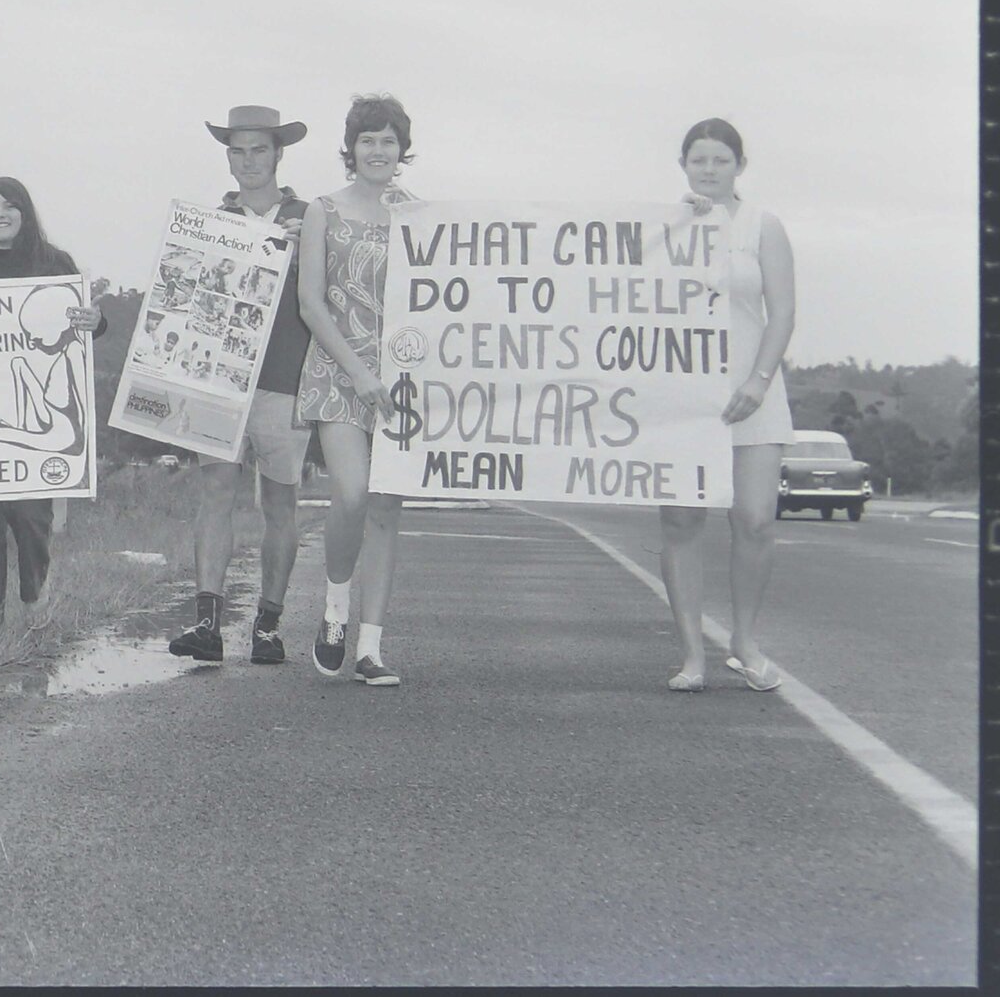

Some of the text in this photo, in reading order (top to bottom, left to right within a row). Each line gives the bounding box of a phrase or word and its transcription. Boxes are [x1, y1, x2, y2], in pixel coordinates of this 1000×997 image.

[170, 222, 254, 253] Christian Action!
[174, 211, 205, 228] World
[400, 221, 537, 266] WHAT
[553, 221, 643, 266] CAN
[409, 276, 470, 313] DO
[497, 276, 555, 314] TO
[438, 322, 729, 374] CENTS COUNT!
[421, 451, 523, 491] MEAN
[565, 456, 677, 500] MORE
